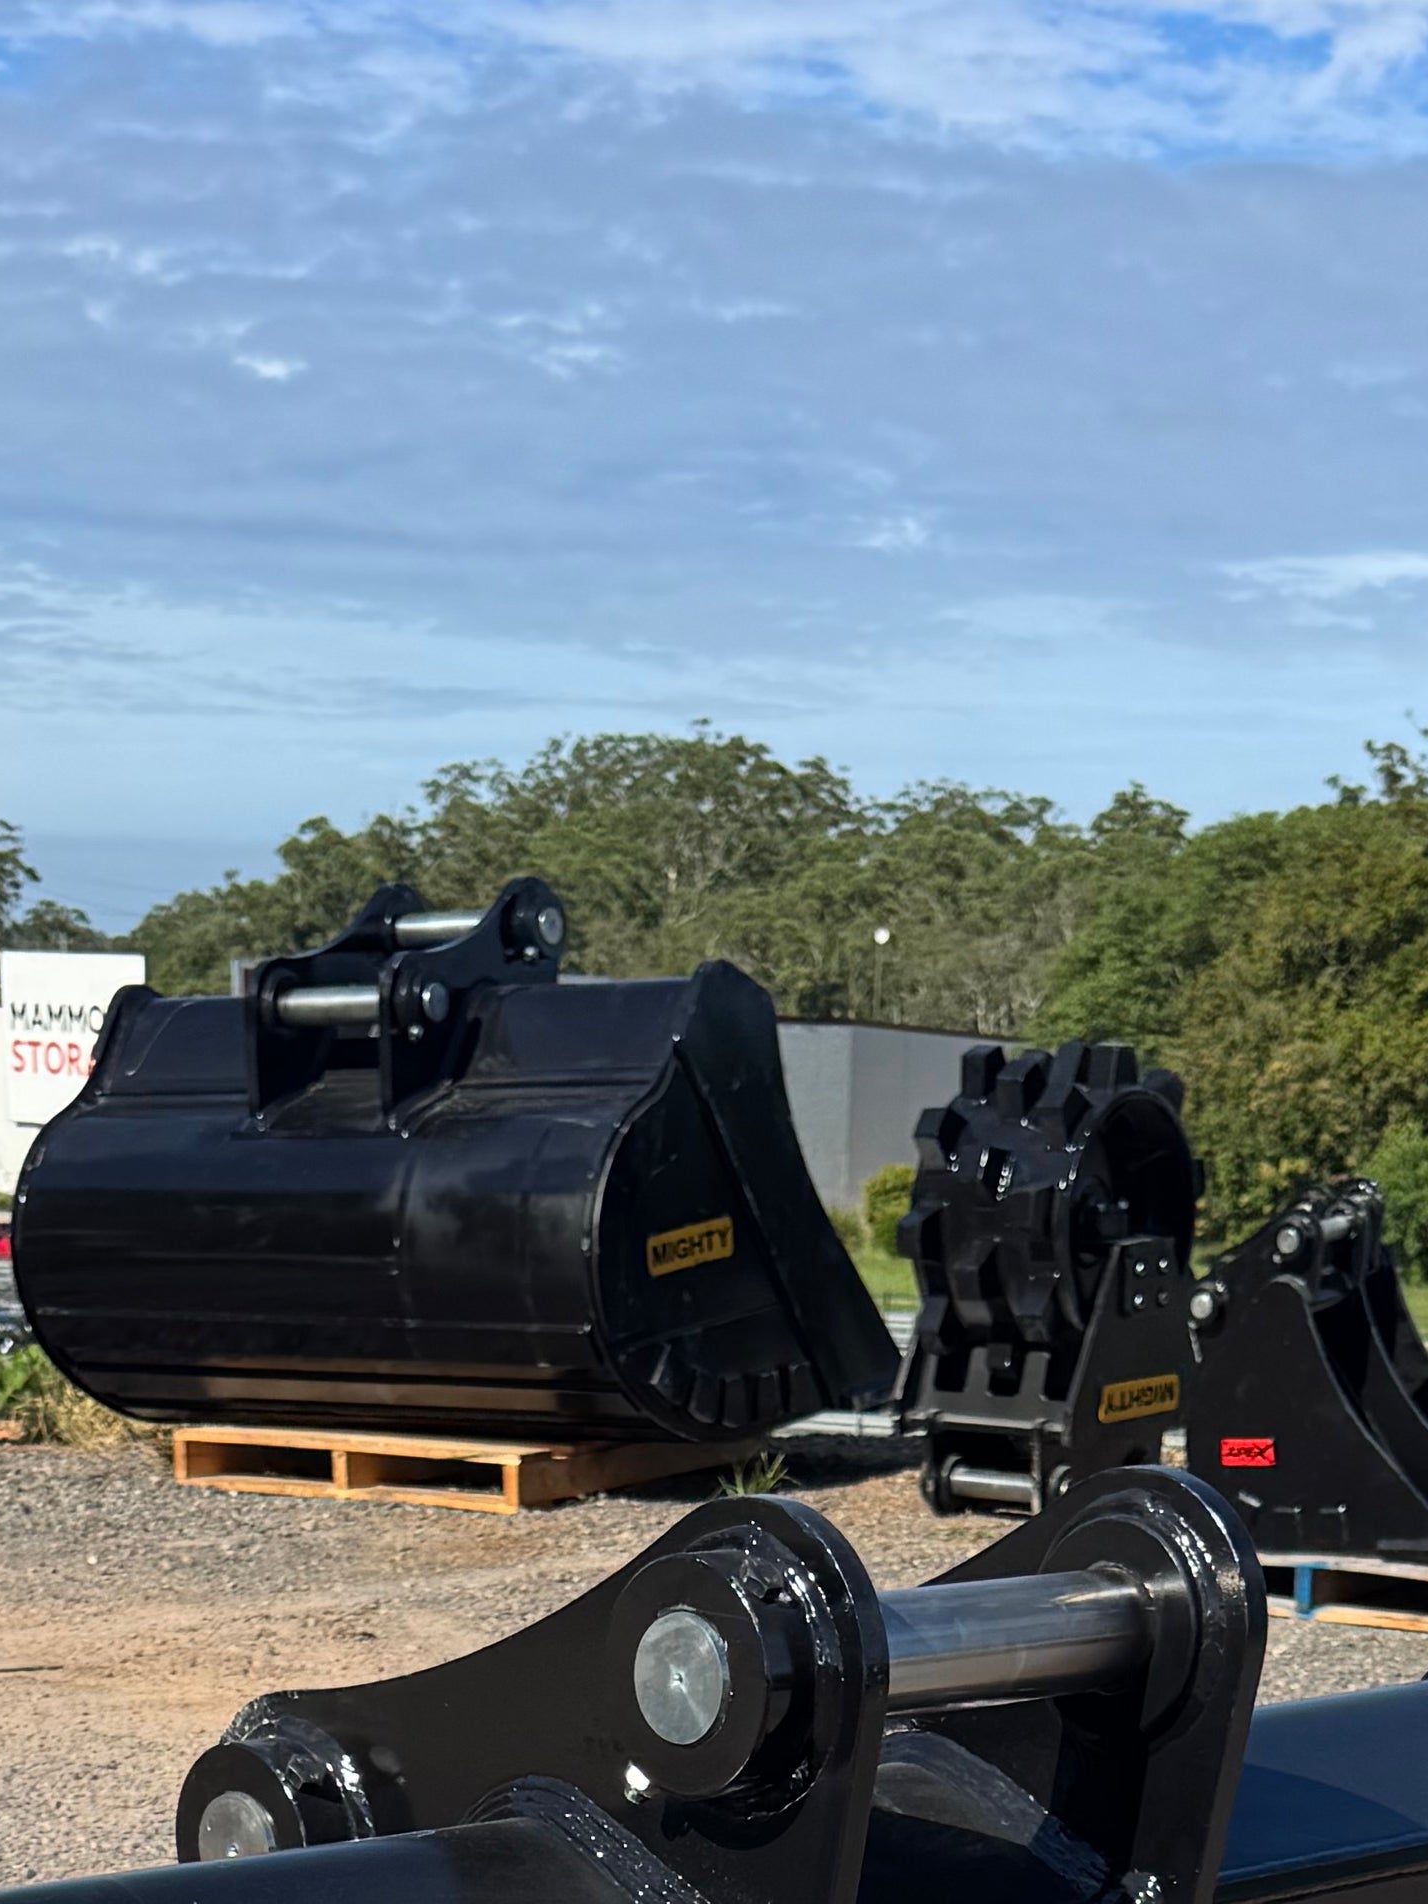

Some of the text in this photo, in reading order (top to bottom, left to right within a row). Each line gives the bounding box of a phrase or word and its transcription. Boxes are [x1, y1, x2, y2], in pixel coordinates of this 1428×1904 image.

[10, 1002, 105, 1034] MAMMO
[11, 1039, 95, 1077] STOR
[652, 1226, 731, 1267] MIGHTY
